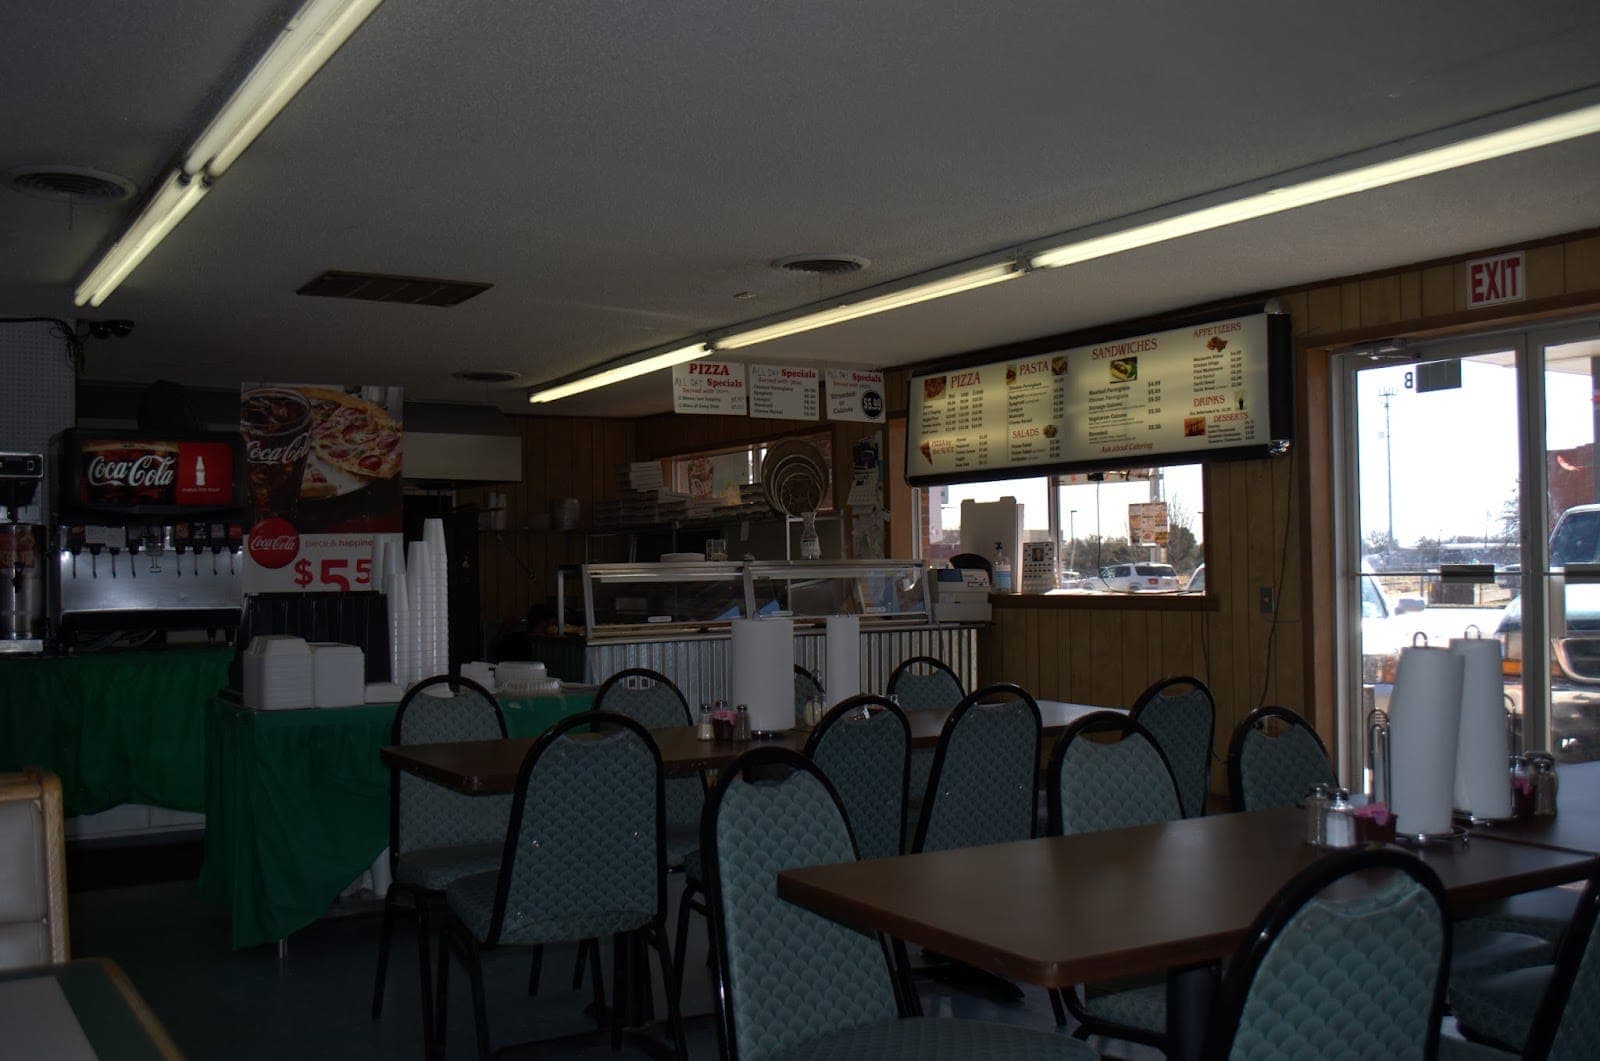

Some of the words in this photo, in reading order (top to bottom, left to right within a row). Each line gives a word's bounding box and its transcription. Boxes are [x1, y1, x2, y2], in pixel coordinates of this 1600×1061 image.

[1471, 257, 1520, 303] EXIT
[1193, 322, 1242, 338] APPETIZERS
[1092, 338, 1158, 360] SANDWICHES
[688, 363, 730, 376] PIZZA
[781, 368, 816, 379] Specials
[1019, 360, 1049, 376] PASTA
[706, 378, 743, 388] Specials
[852, 373, 881, 383] Specials
[951, 372, 981, 389] PIZZA
[1193, 395, 1225, 408] DRINKS
[1213, 412, 1249, 423] DESSERTS
[1012, 427, 1039, 439] SALADS
[88, 454, 176, 487] Coca-Cola
[251, 535, 297, 551] Coca-Cola
[338, 539, 373, 548] happine
